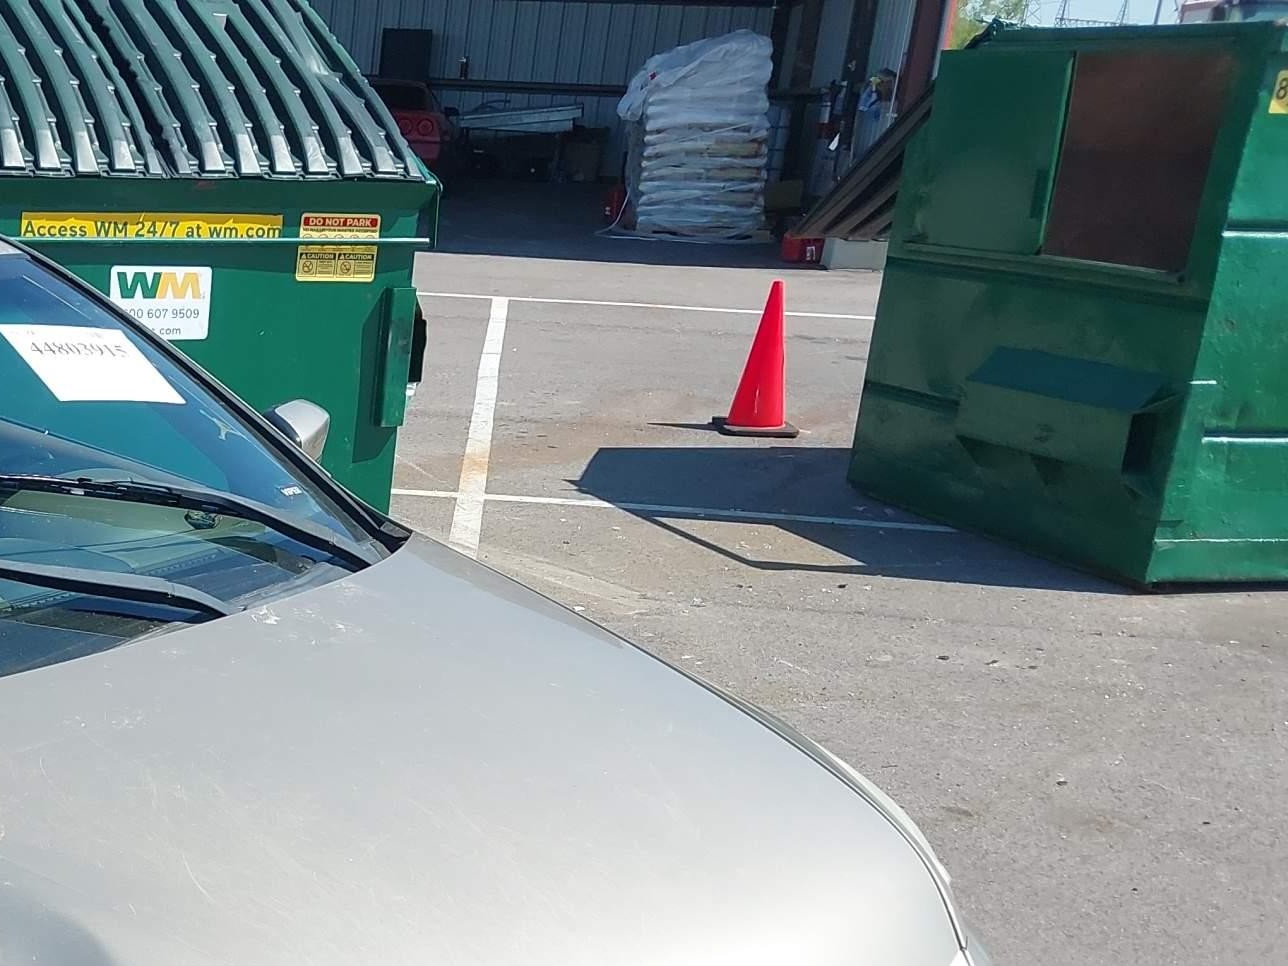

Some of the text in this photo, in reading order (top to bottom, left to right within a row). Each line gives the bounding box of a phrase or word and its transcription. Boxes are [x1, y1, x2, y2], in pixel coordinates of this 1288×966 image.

[23, 220, 282, 239] Access WM 24/7 at wm.com
[309, 217, 372, 227] DO NOT PARK
[116, 271, 201, 299] WM
[147, 308, 169, 319] 607
[171, 308, 200, 319] 9509
[31, 341, 129, 358] 44803915
